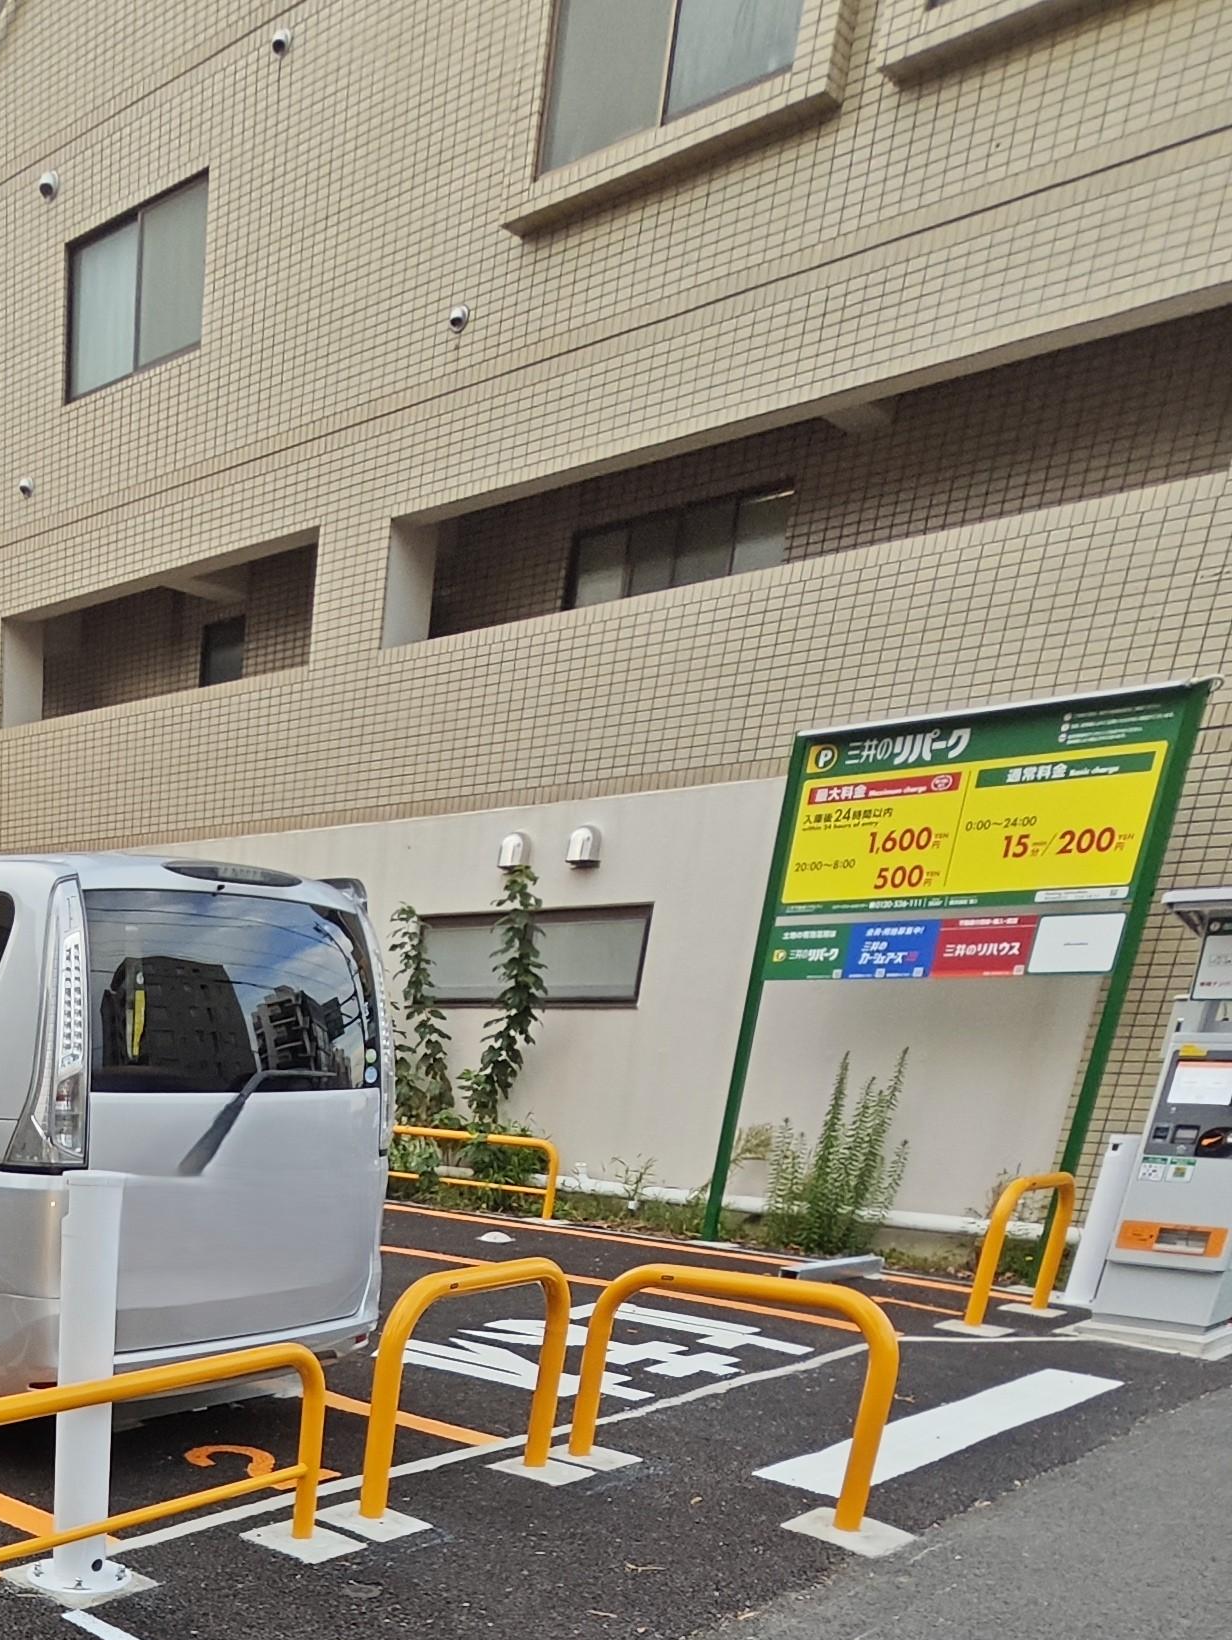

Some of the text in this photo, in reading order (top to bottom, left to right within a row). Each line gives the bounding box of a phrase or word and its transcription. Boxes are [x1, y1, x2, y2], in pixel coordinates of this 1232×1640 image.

[845, 728, 971, 765] 三井のリパーク
[818, 749, 833, 768] P
[1006, 763, 1068, 784] 通常料金
[1091, 765, 1120, 775] charge
[815, 784, 867, 803] 最大料金
[903, 785, 927, 795] charge
[803, 807, 893, 825] 入庫後24時間以内
[868, 826, 932, 854] 1,600
[1002, 833, 1030, 859] 15
[1056, 827, 1116, 855] 200
[873, 864, 925, 890] 500
[788, 948, 839, 962] 三井のリパーク
[943, 942, 1021, 957] 三井のリハウス
[184, 1444, 342, 1490] 2
